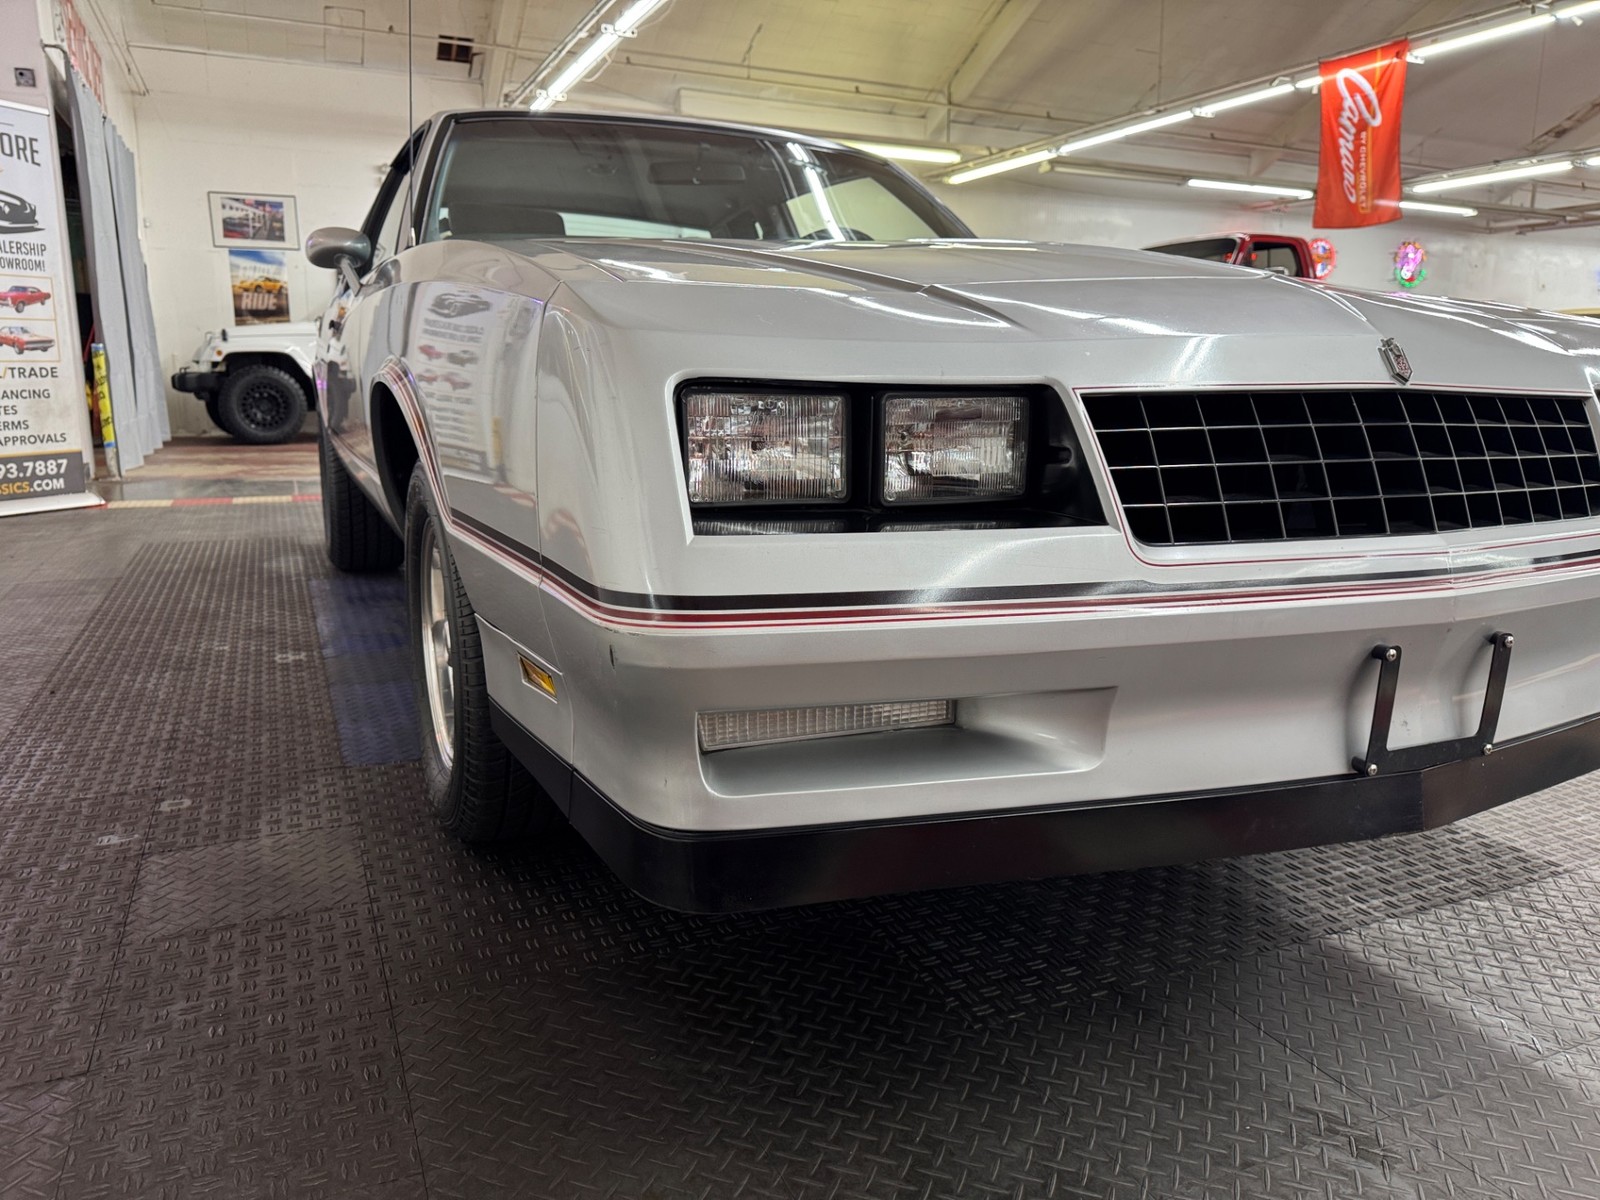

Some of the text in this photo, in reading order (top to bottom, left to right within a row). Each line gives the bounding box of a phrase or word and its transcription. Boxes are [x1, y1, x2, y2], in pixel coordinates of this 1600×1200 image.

[1336, 68, 1382, 203] Camaro
[0, 132, 41, 167] ORE
[1359, 131, 1367, 208] BY CHEVROLET
[241, 292, 277, 310] RIDE
[0, 366, 59, 379] /TRADE
[1, 388, 51, 400] ANCING
[0, 477, 65, 496] SICS.COM
